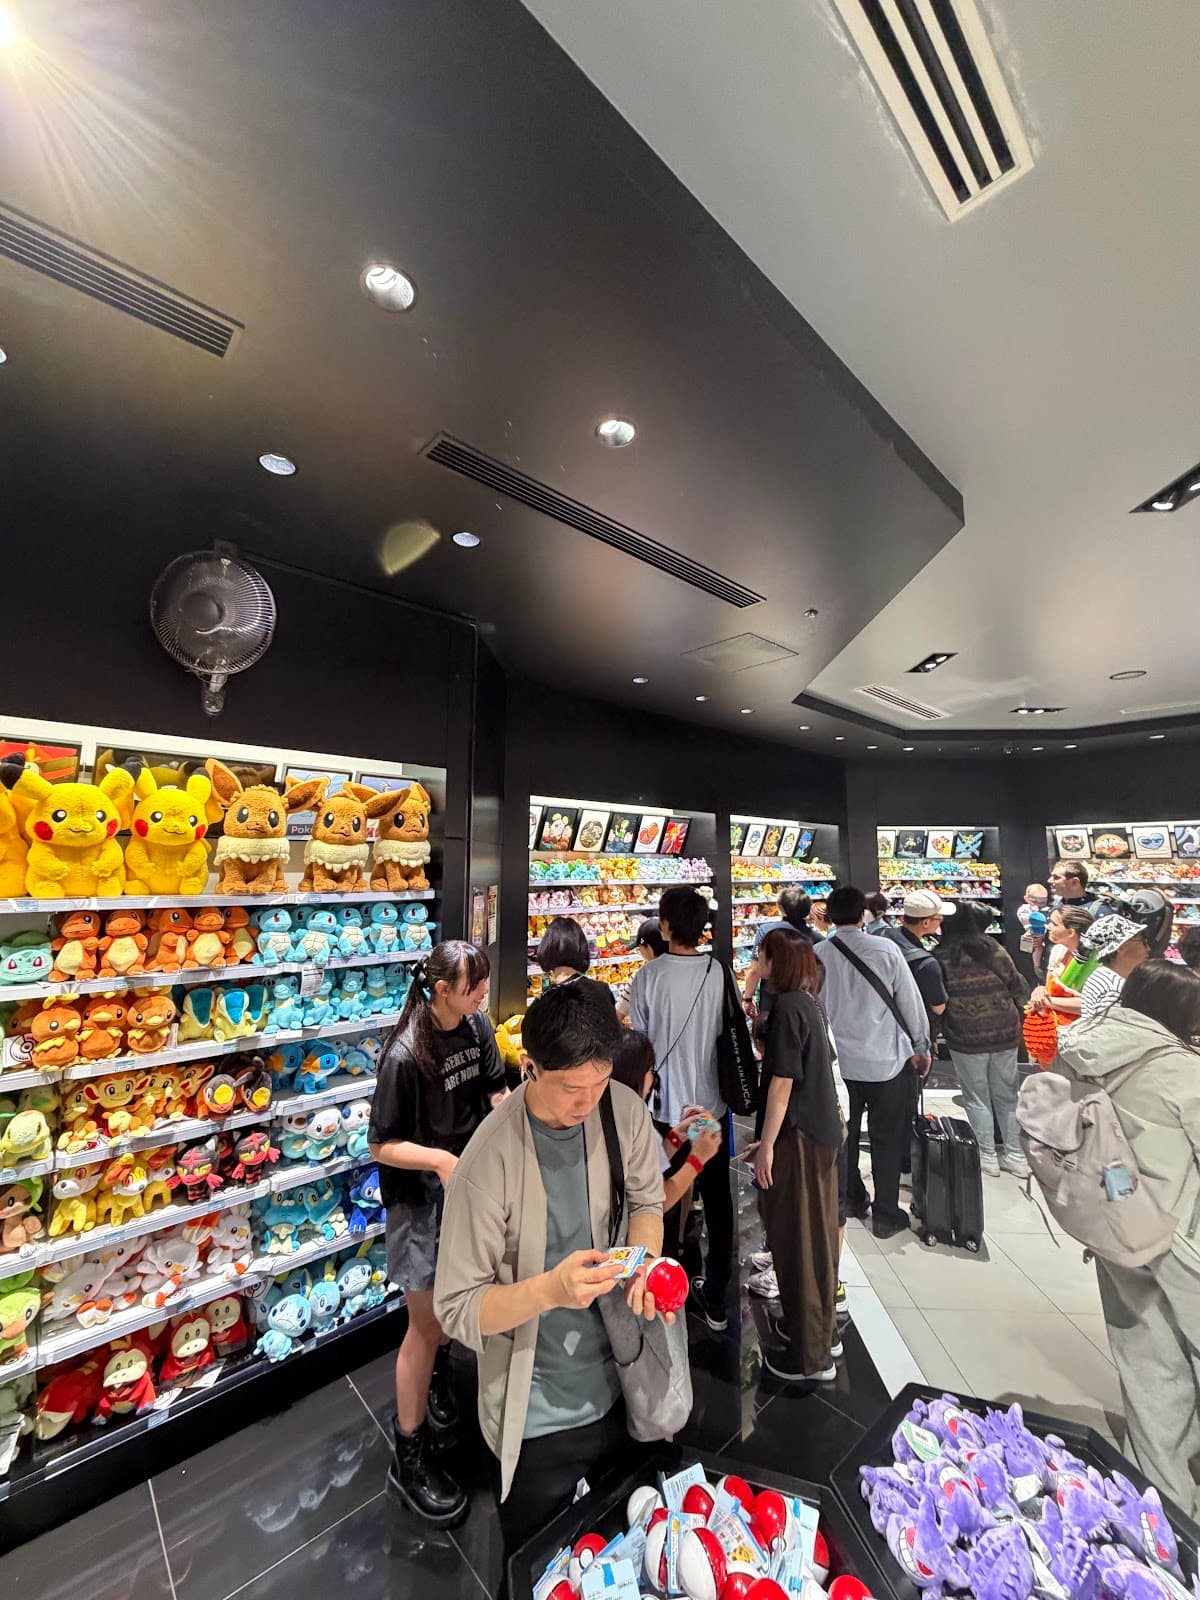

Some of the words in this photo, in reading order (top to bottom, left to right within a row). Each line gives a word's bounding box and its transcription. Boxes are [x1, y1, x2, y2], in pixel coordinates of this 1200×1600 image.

[291, 825, 313, 834] Pok
[730, 1027, 739, 1055] DEAN
[738, 1065, 752, 1108] DELUCA
[444, 1072, 460, 1092] ARE
